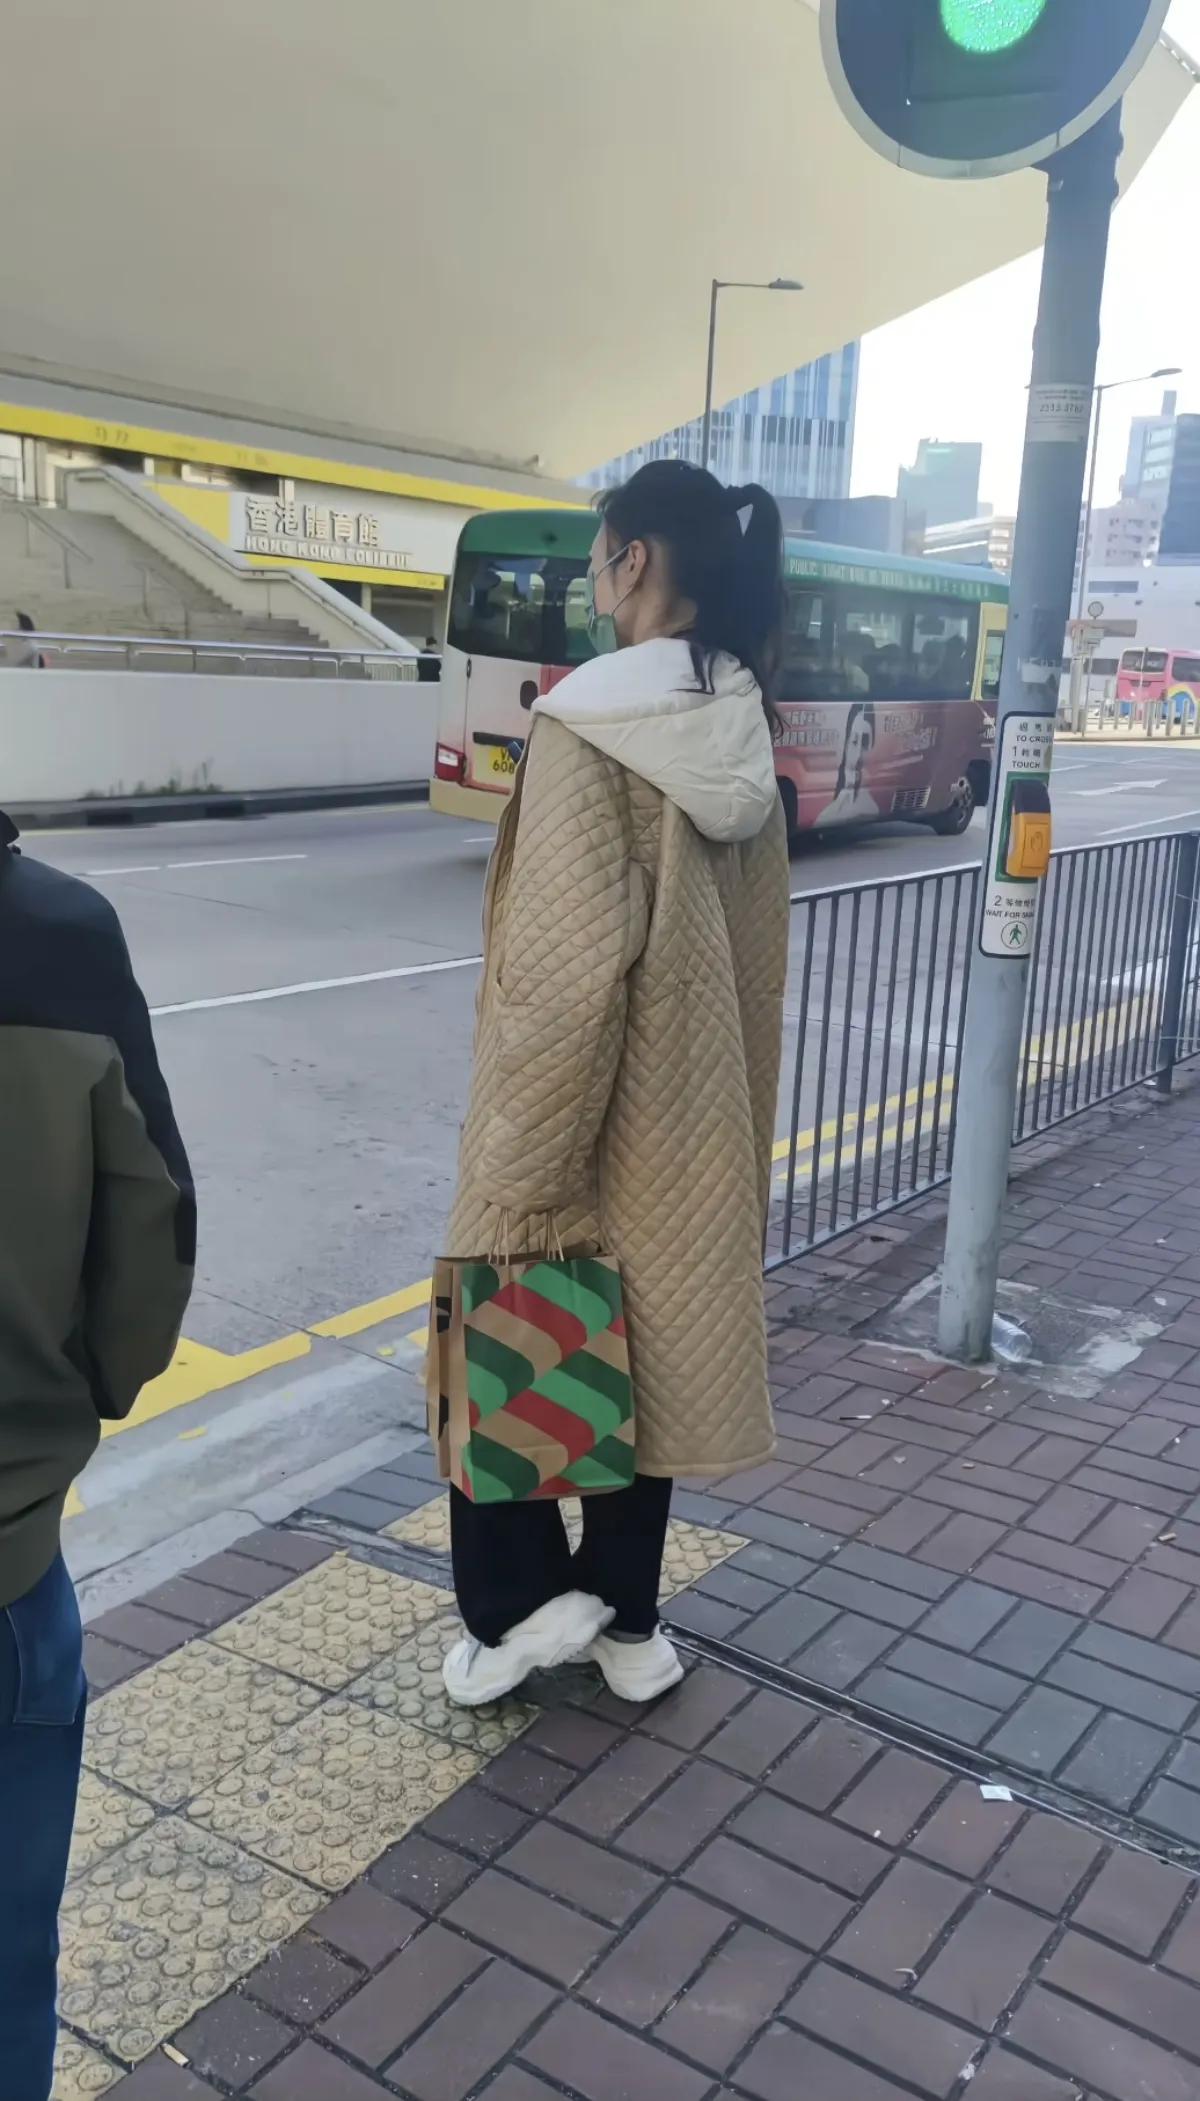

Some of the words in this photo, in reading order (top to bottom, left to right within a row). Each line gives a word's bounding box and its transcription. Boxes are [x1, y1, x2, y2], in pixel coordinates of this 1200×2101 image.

[246, 498, 380, 547] 香港體育館
[1012, 760, 1041, 769] TOUCH
[994, 894, 1002, 907] 2
[985, 909, 1003, 918] WAIT
